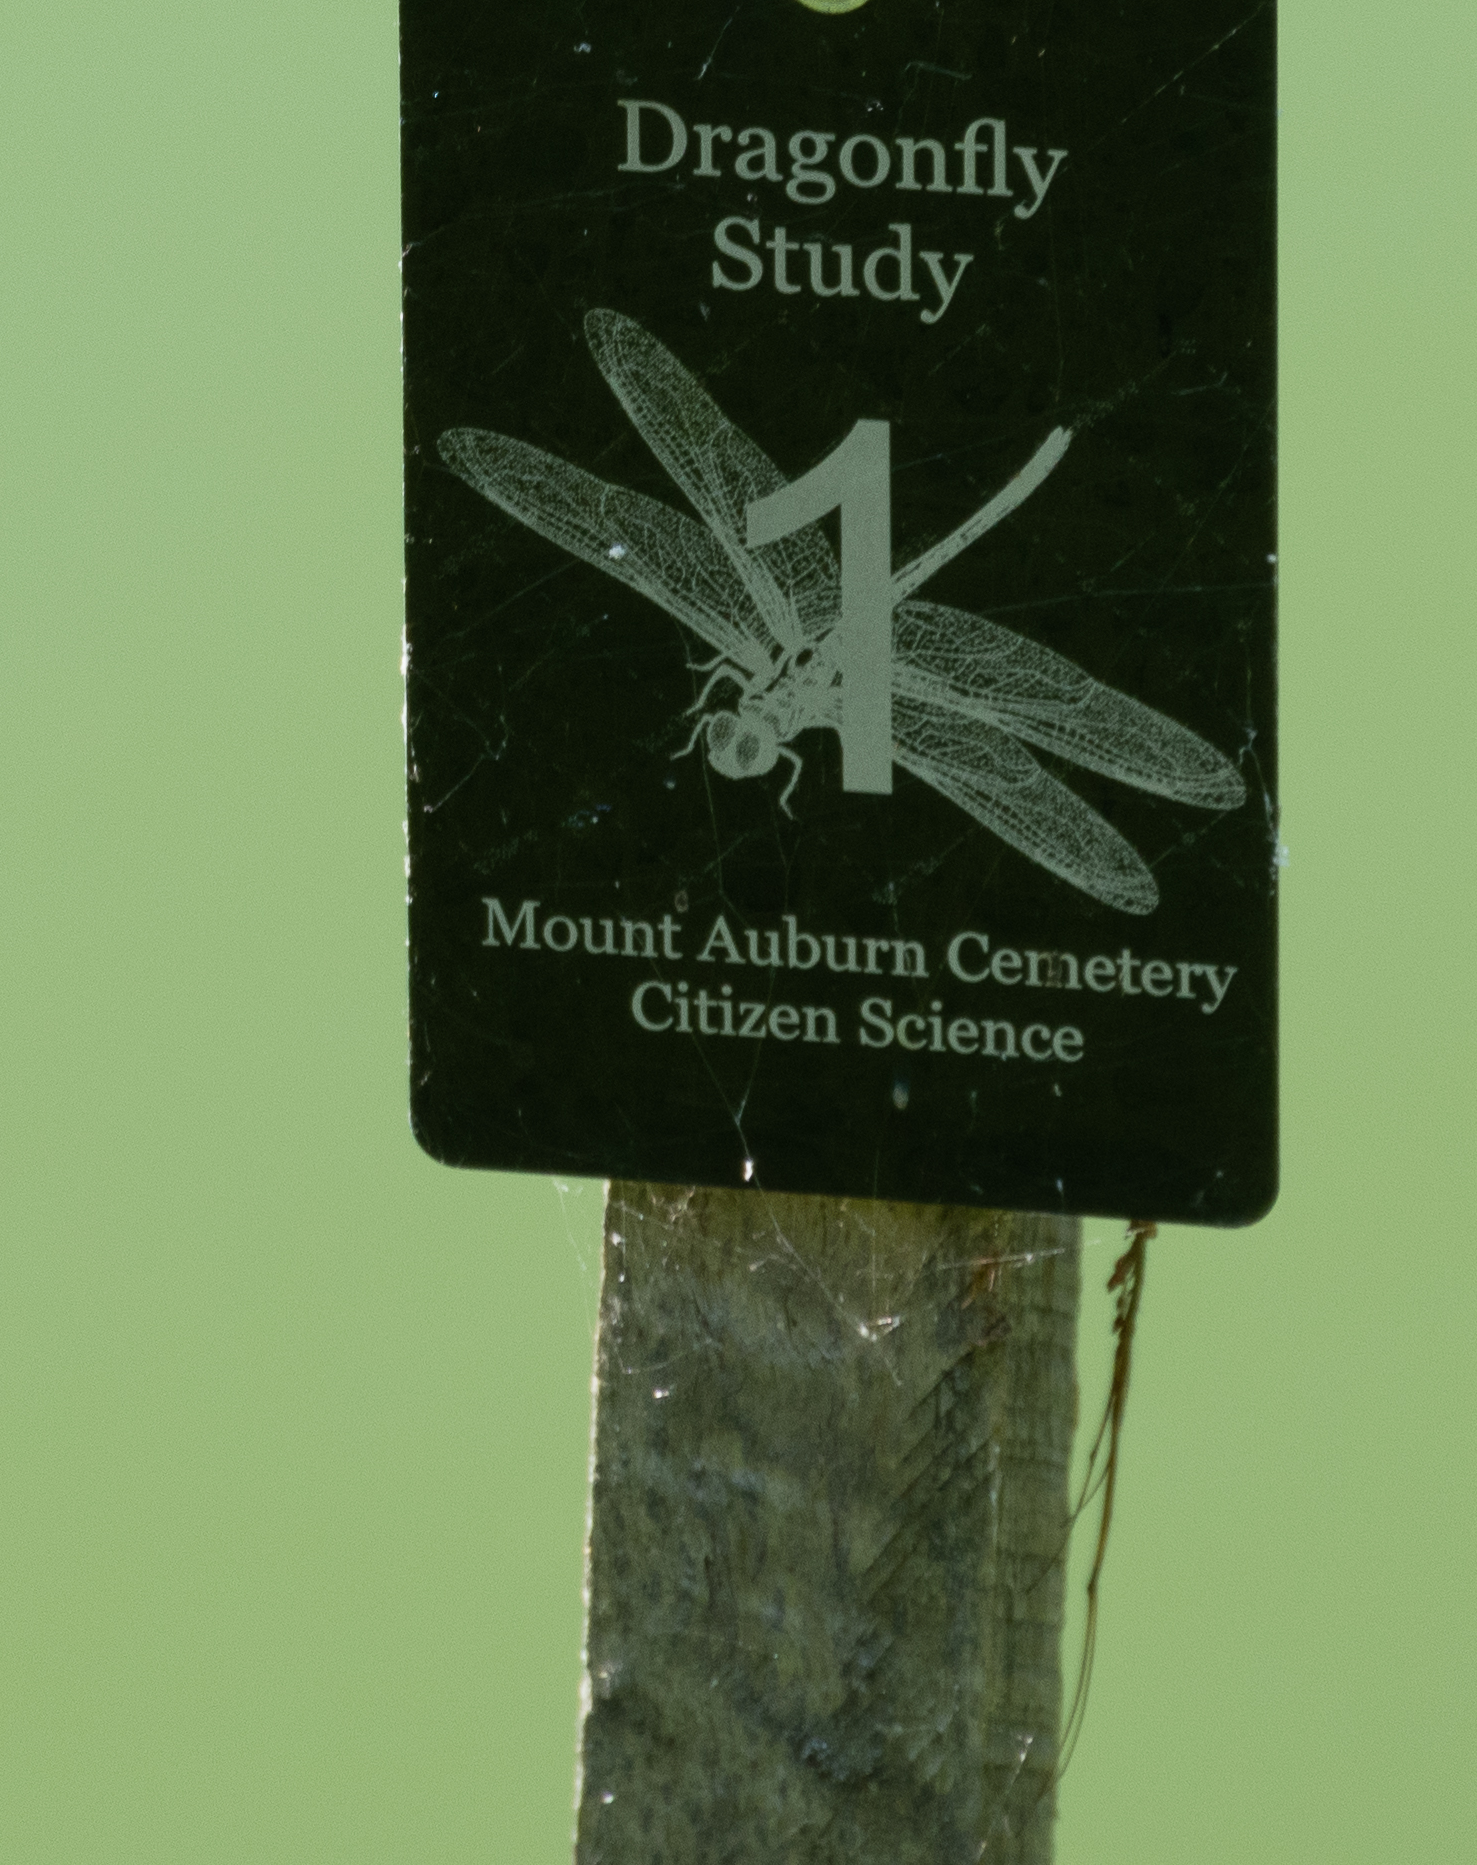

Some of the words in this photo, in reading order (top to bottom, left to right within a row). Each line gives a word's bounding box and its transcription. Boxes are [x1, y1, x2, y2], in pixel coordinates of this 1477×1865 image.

[617, 99, 1068, 219] Dragonfly
[712, 216, 974, 324] Study
[745, 419, 893, 796] 1
[482, 897, 683, 960] Mount
[696, 915, 929, 978] Auburn
[947, 931, 1238, 1014] Cemetery
[631, 980, 840, 1043] Citizen
[859, 997, 1084, 1062] Science
